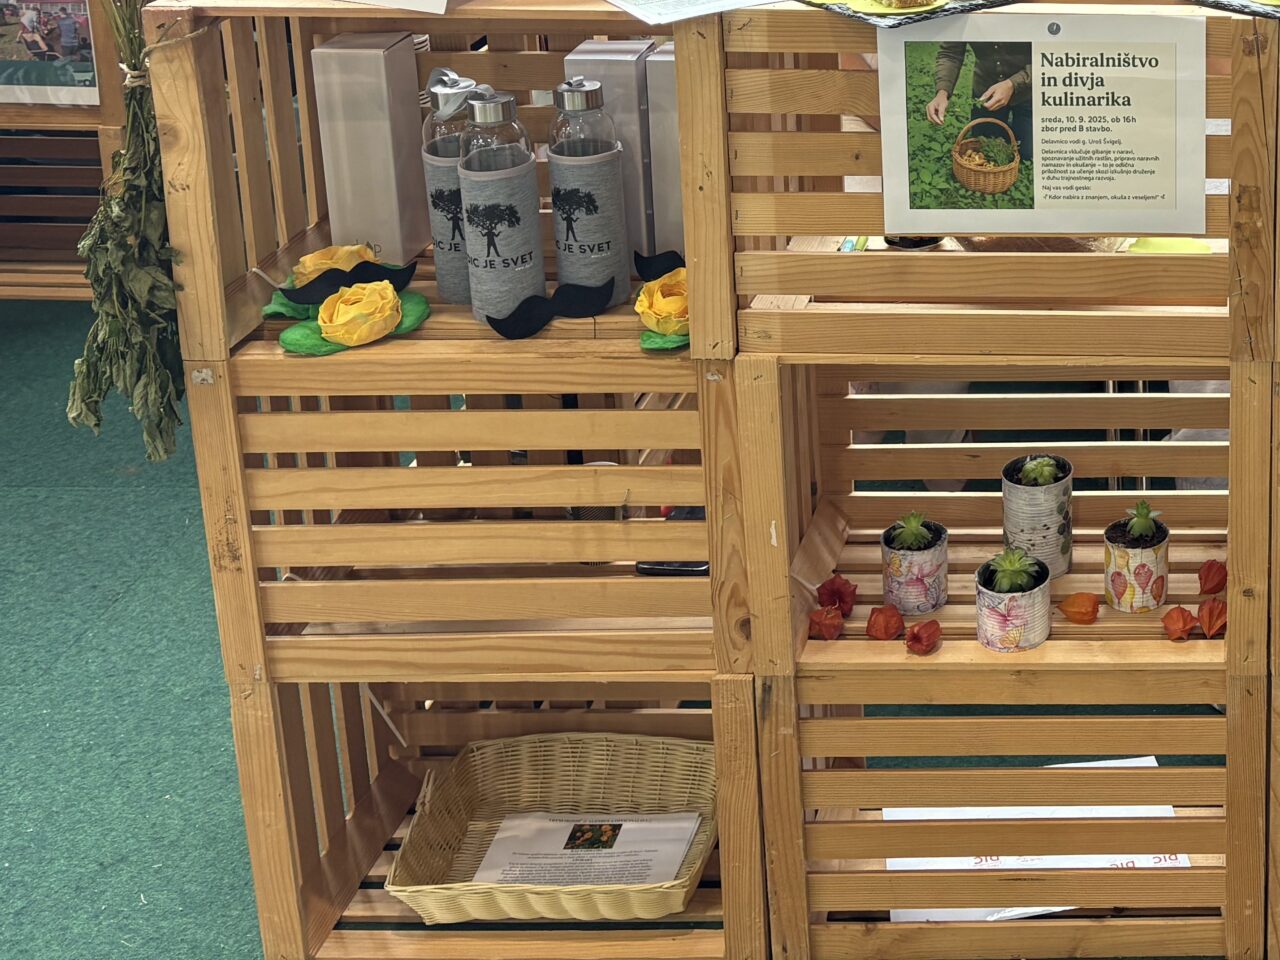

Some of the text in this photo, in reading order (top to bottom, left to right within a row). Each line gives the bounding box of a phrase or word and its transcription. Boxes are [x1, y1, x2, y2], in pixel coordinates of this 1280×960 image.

[1040, 52, 1159, 68] Nabiralništvo
[1041, 72, 1105, 90] in divja
[1041, 92, 1132, 107] kulinarika
[1041, 116, 1064, 124] sreda,
[1088, 116, 1109, 124] 2025,
[1059, 125, 1076, 133] pred
[448, 243, 461, 252] JE
[563, 240, 612, 253] JE SVET
[483, 250, 534, 269] JE SVET
